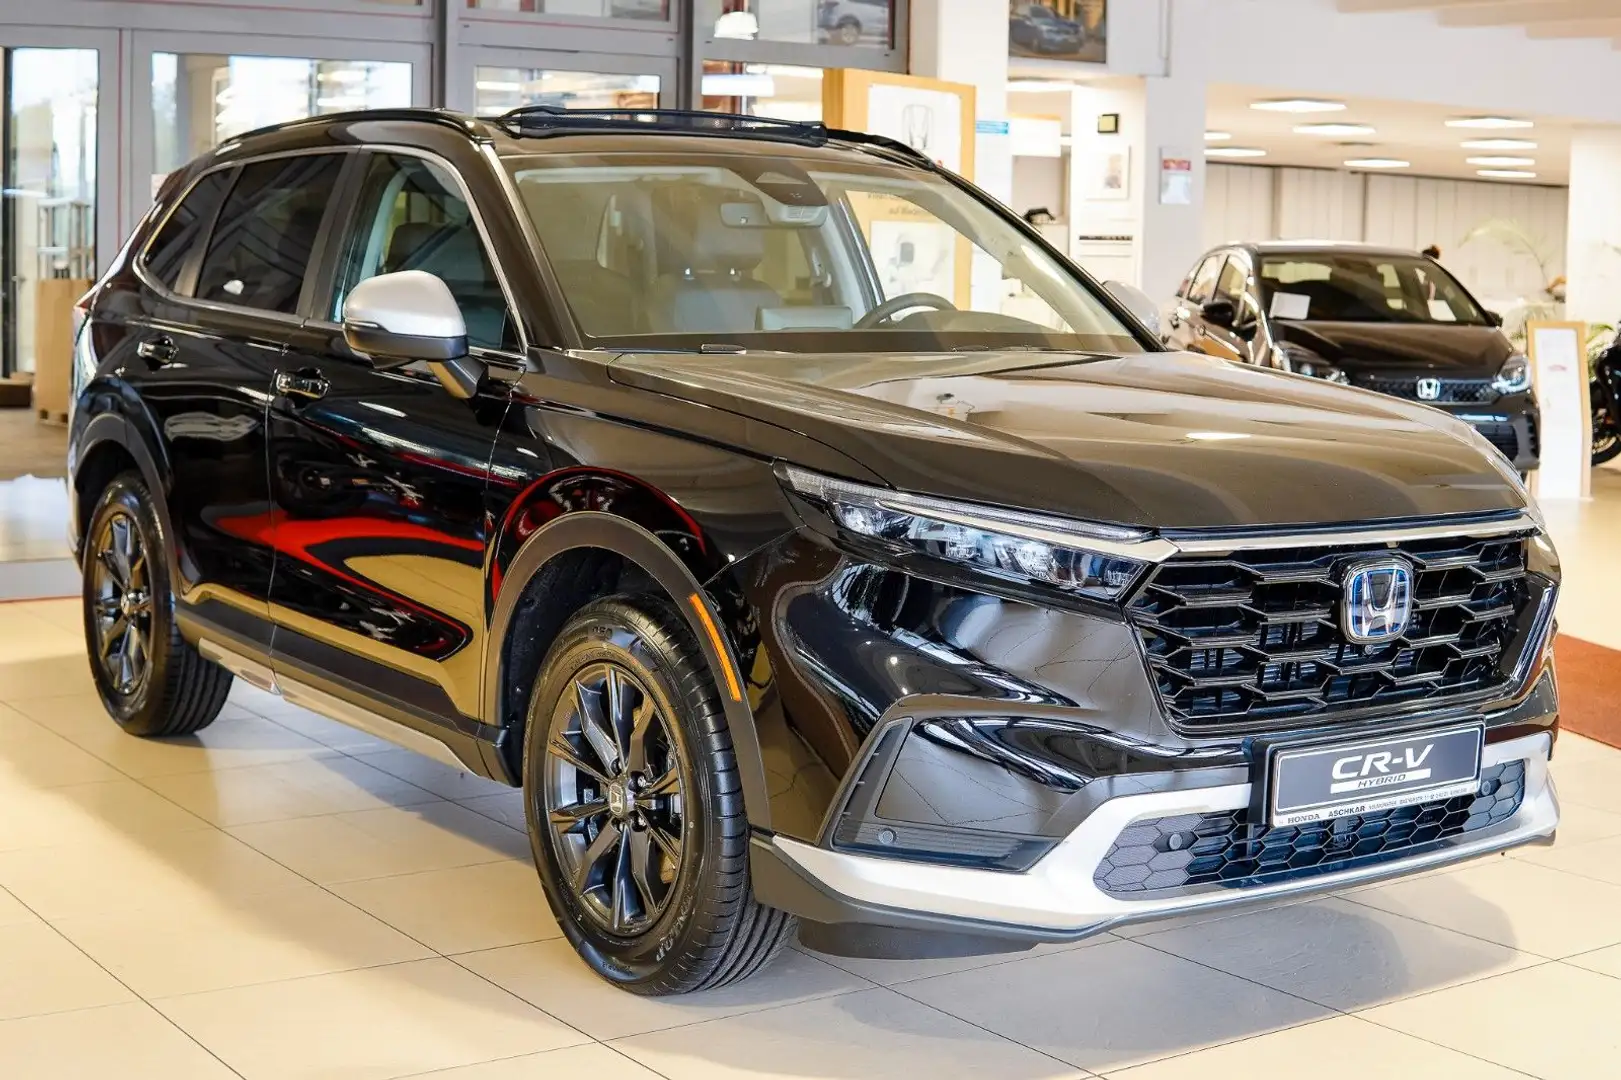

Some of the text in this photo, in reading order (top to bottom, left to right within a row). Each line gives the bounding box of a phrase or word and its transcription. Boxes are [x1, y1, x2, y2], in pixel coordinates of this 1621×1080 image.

[1332, 744, 1434, 780] CR-V
[1357, 773, 1407, 788] HYBRID
[1287, 804, 1366, 825] HONDA ASCHKAR
